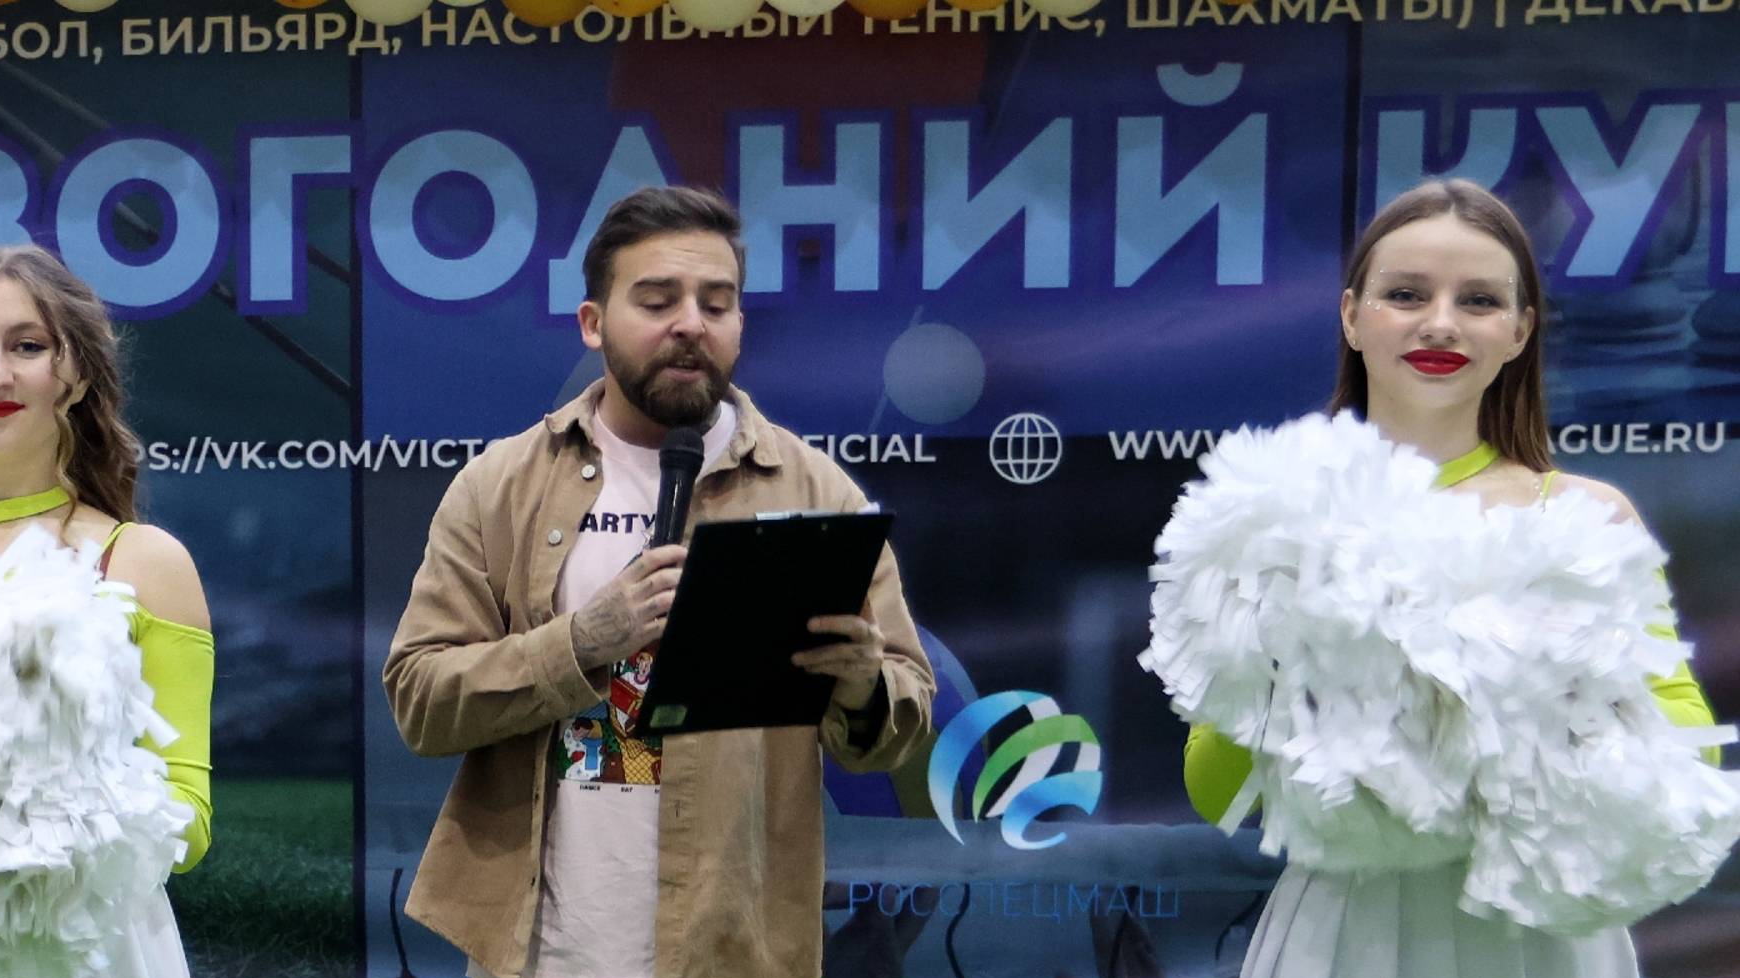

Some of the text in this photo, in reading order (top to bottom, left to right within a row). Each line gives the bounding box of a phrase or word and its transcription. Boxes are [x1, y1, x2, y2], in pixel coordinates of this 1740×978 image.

[122, 11, 402, 56] БИЛЬЯРД,
[1108, 430, 1217, 460] WW
[1547, 422, 1725, 454] GUE.RU
[848, 880, 1180, 924] РОССПЕЦМАШ
